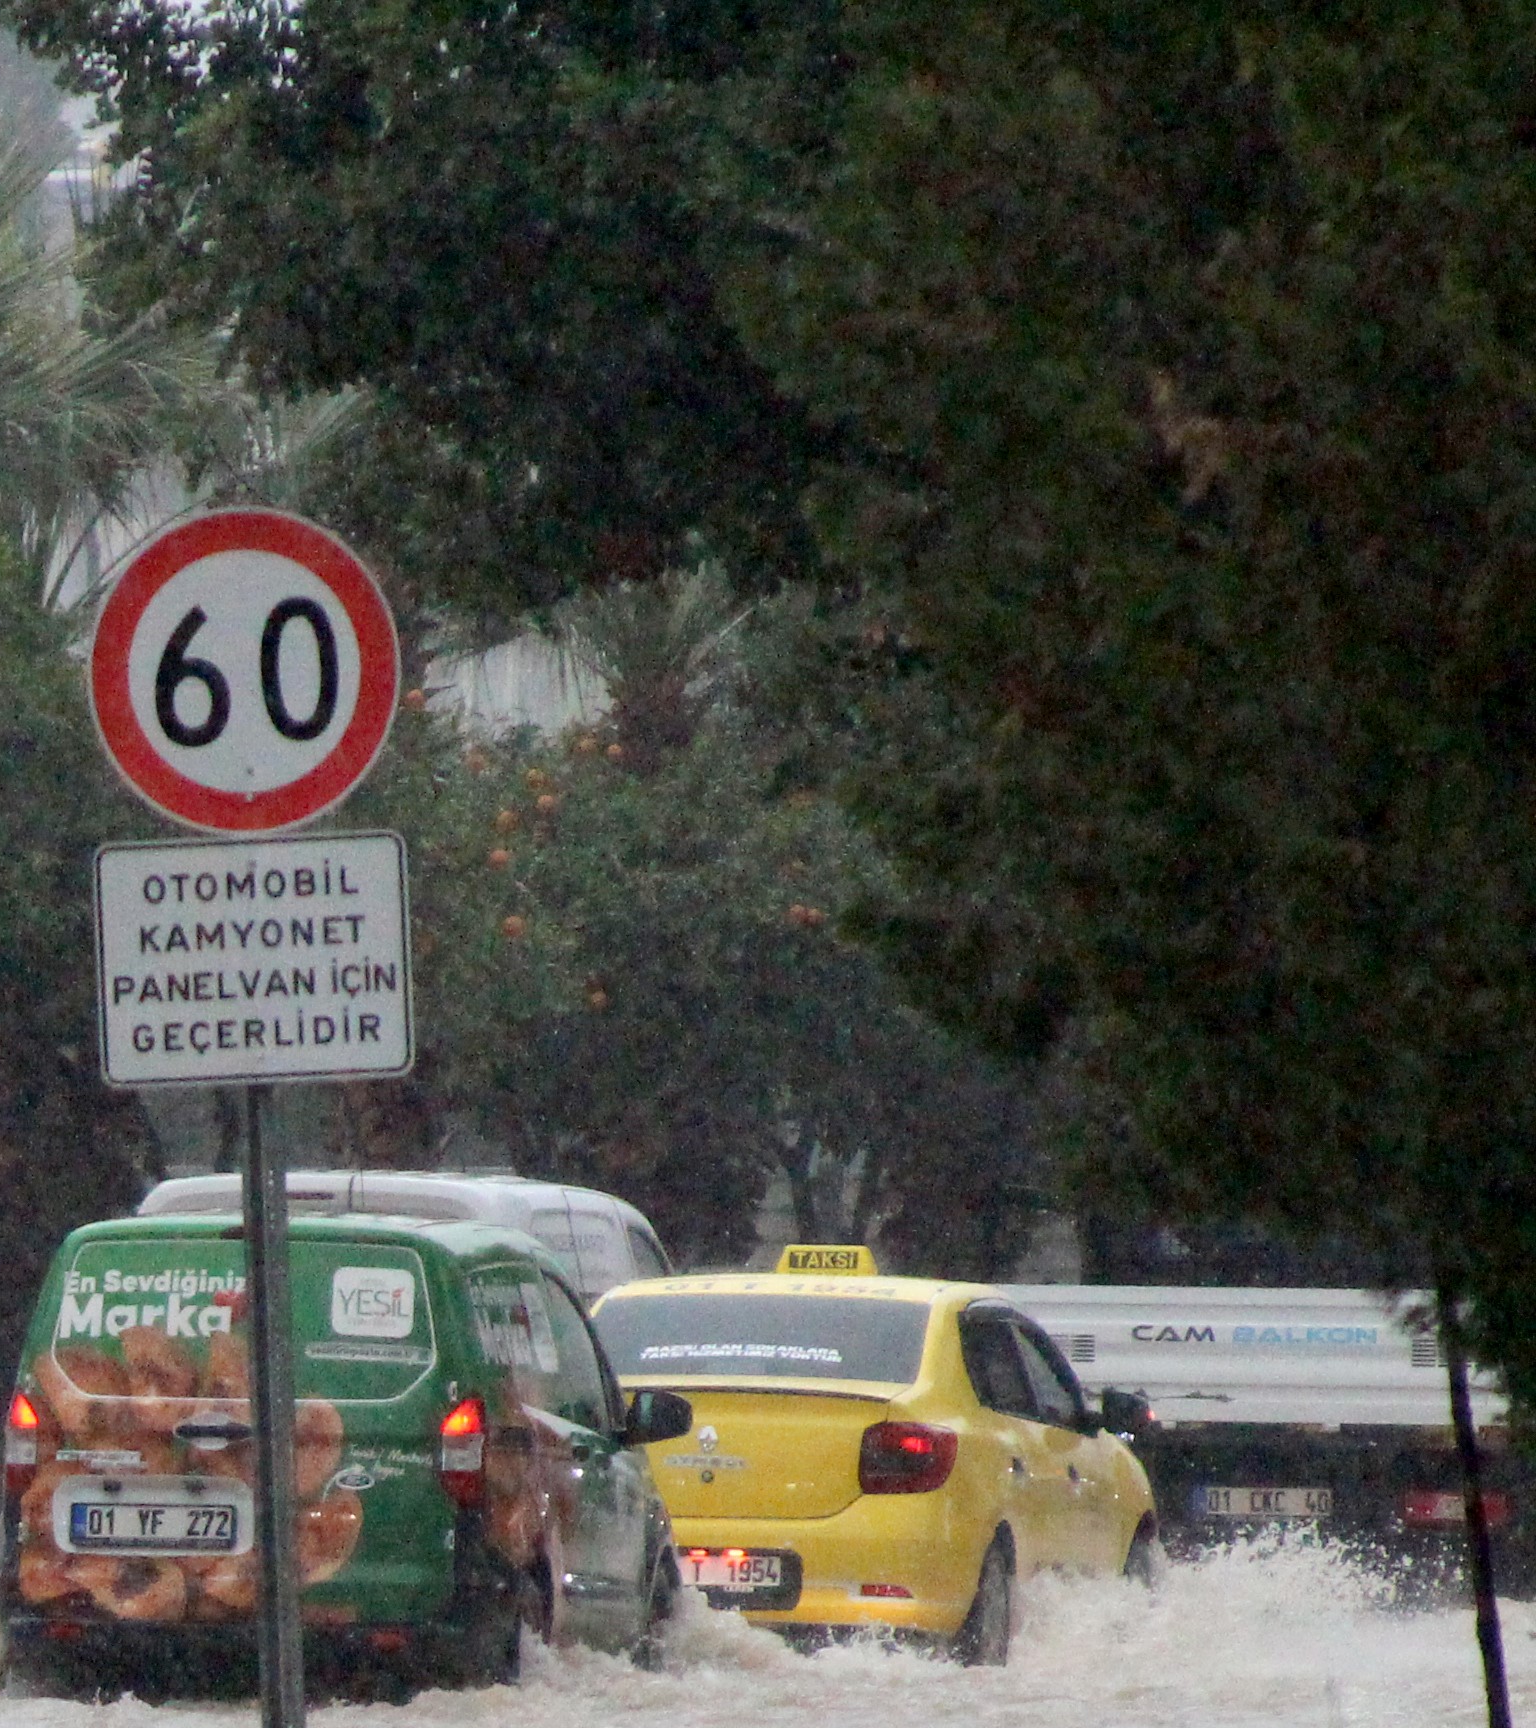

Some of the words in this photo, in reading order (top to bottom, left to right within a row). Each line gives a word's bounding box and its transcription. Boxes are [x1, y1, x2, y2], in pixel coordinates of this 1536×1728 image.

[154, 595, 340, 747] 60
[142, 861, 360, 905] OTOMOBİL
[140, 914, 365, 954] KAMYONET
[113, 967, 317, 1005] PANELVAN
[330, 955, 398, 1000] İÇİN
[133, 1005, 382, 1055] GEÇERLİDİR
[64, 1271, 97, 1294] En
[103, 1269, 247, 1299] Sevdiğiniz
[60, 1292, 233, 1339] Marka
[1131, 1324, 1217, 1343] CAM
[1231, 1325, 1378, 1345] BALKON
[1208, 1489, 1231, 1513] 01
[88, 1508, 116, 1536] 01
[137, 1509, 166, 1536] YF
[186, 1510, 230, 1537] 272
[727, 1559, 779, 1583] 1954
